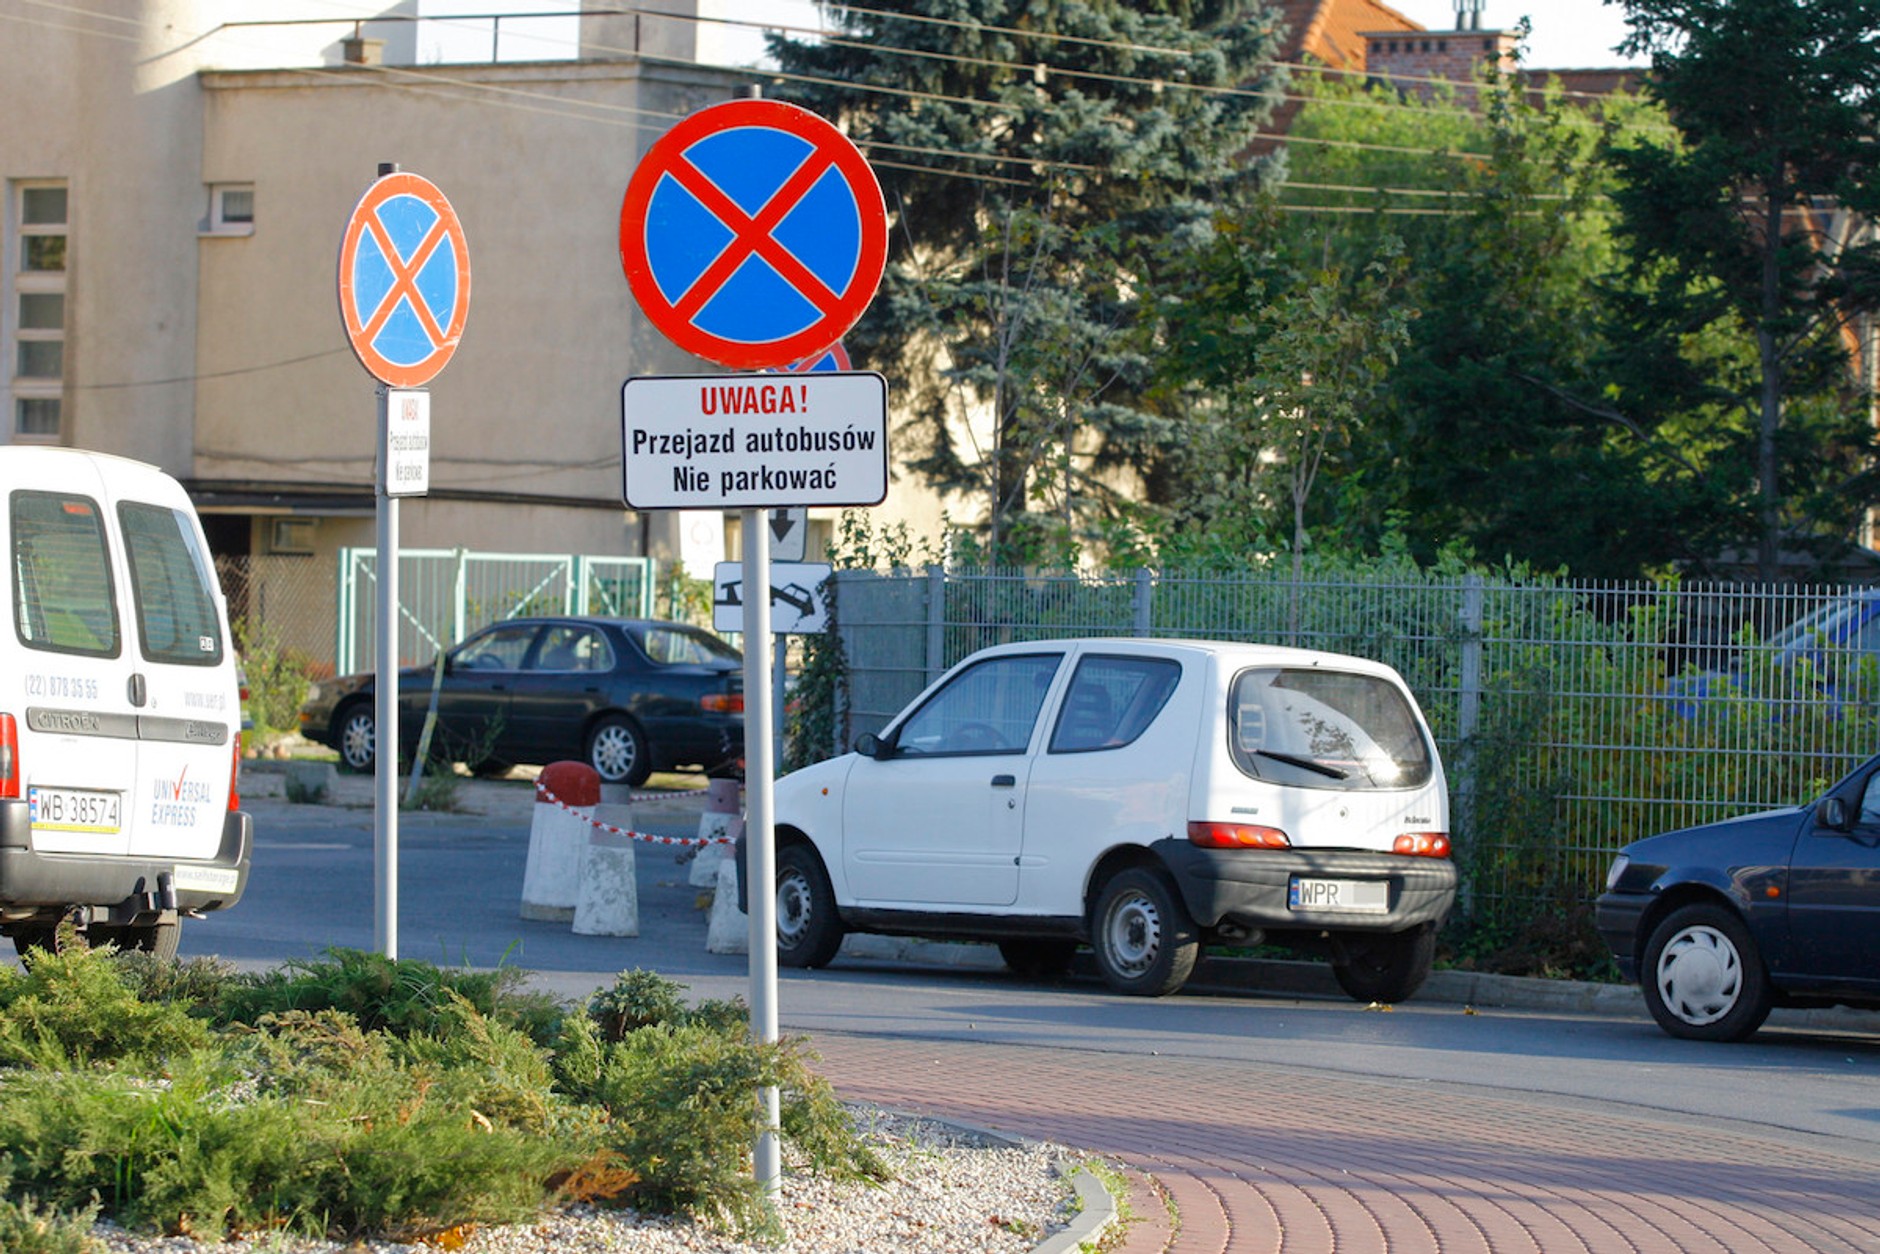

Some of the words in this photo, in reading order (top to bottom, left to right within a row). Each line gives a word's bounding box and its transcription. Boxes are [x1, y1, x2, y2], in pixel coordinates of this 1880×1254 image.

[701, 384, 808, 416] UWAGA!
[633, 427, 735, 459] Przejazd
[746, 424, 876, 453] autobusów
[673, 466, 710, 492] Nie
[721, 463, 837, 496] parkować
[25, 674, 46, 698] (22)
[50, 676, 69, 698] 878
[70, 677, 83, 699] 35
[85, 679, 98, 700] 55
[38, 710, 100, 732] CITROËN
[153, 764, 211, 803] UNIVERSAL
[41, 793, 64, 821] WB
[70, 796, 118, 825] 38574
[151, 803, 197, 827] EXPRESS
[1301, 882, 1340, 905] WPR
